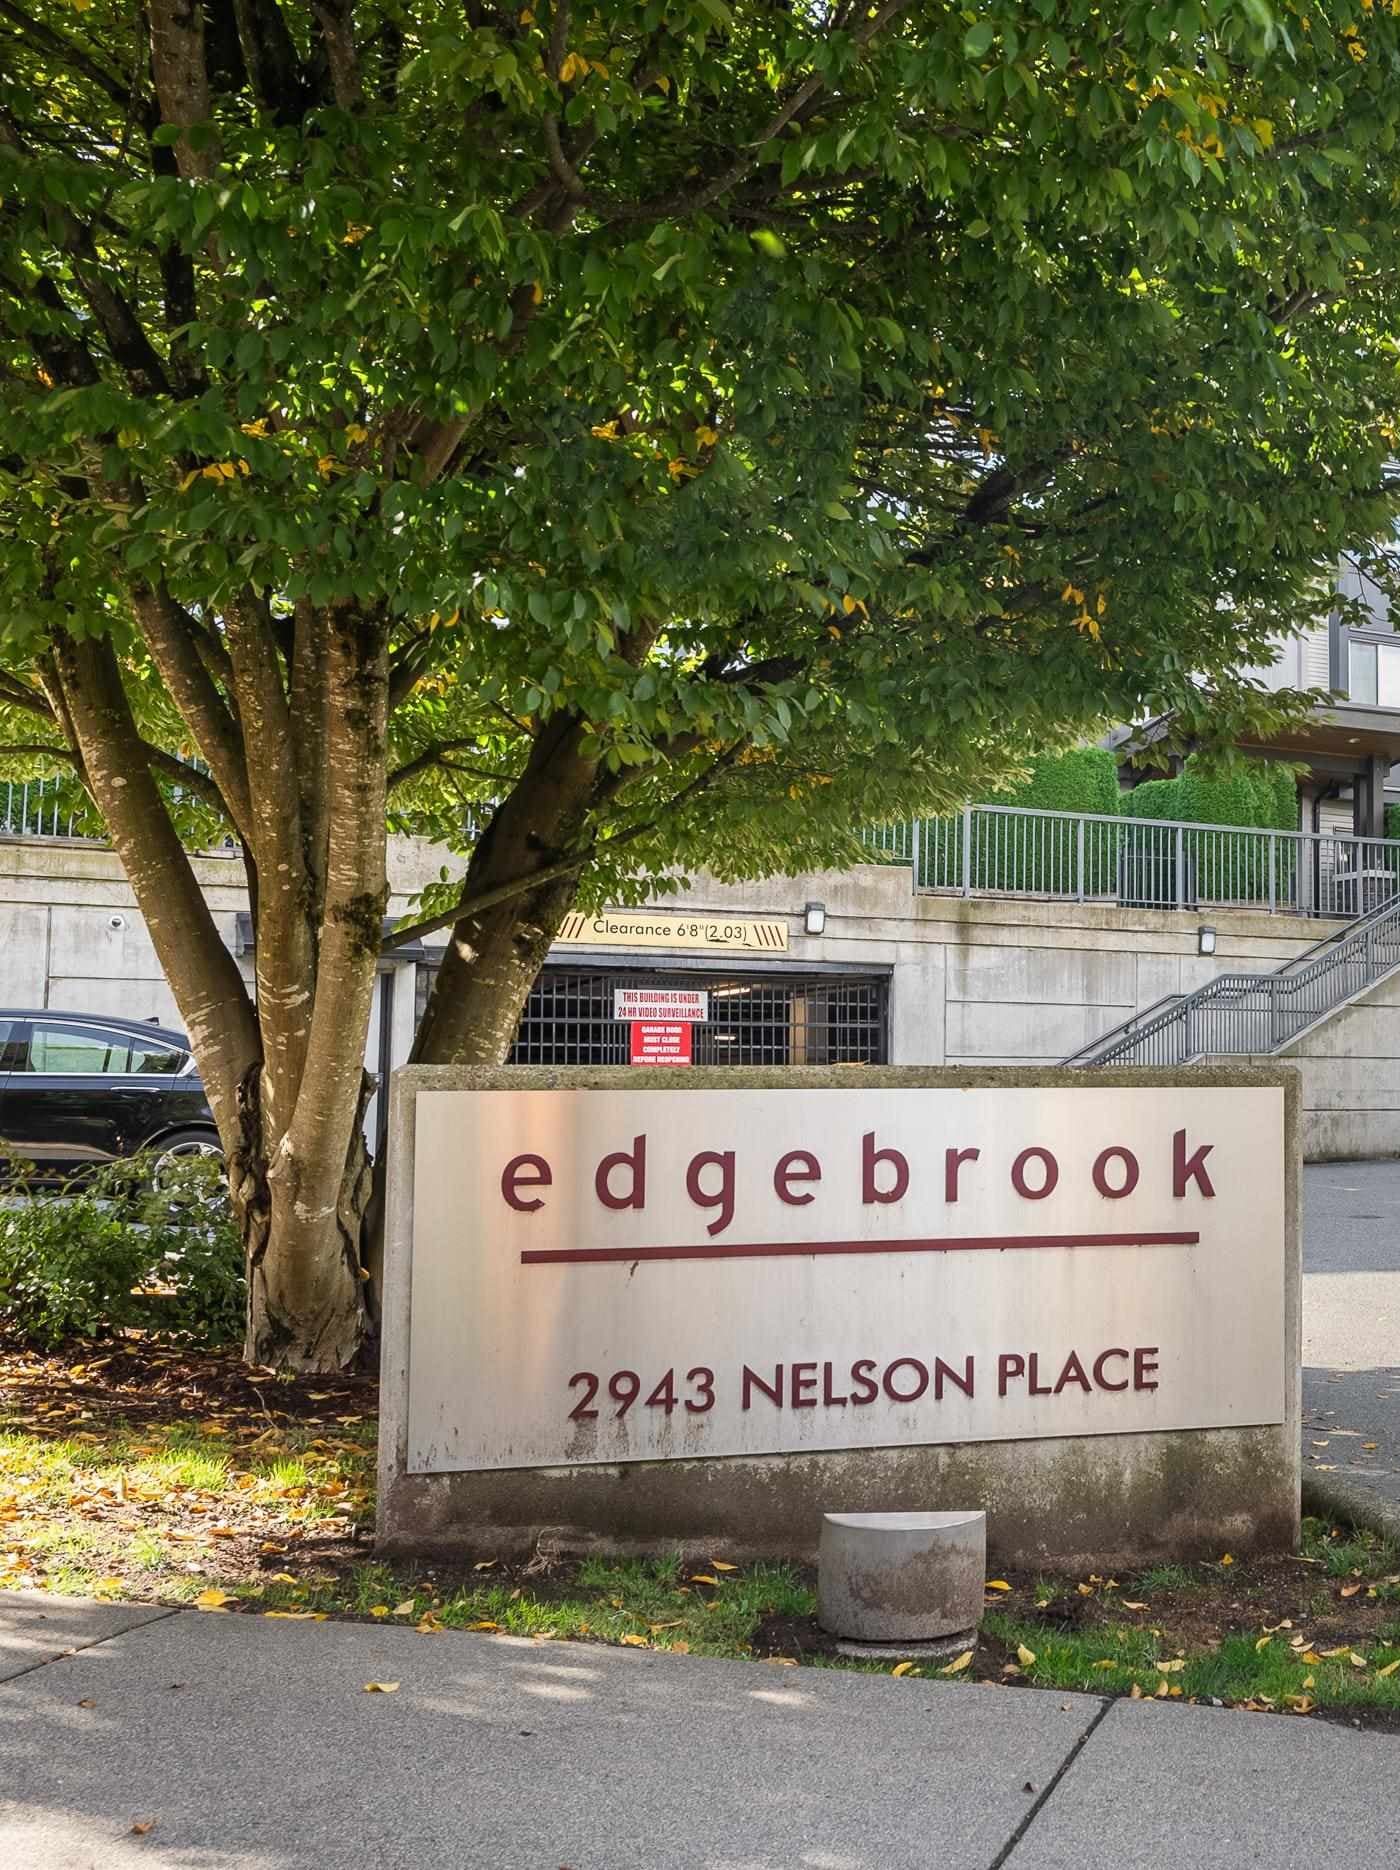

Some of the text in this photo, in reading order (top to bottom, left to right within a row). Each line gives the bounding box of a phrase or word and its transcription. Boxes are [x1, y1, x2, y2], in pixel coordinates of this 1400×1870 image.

[593, 920, 671, 936] Clearance
[623, 991, 700, 1004] THIS BUILDING IS UNDER
[618, 1006, 704, 1019] 24 HR VIDEO SURVEILLANCE
[501, 1129, 1216, 1237] edgebrook
[567, 1347, 1160, 1420] 2943 NELSON PLACE
